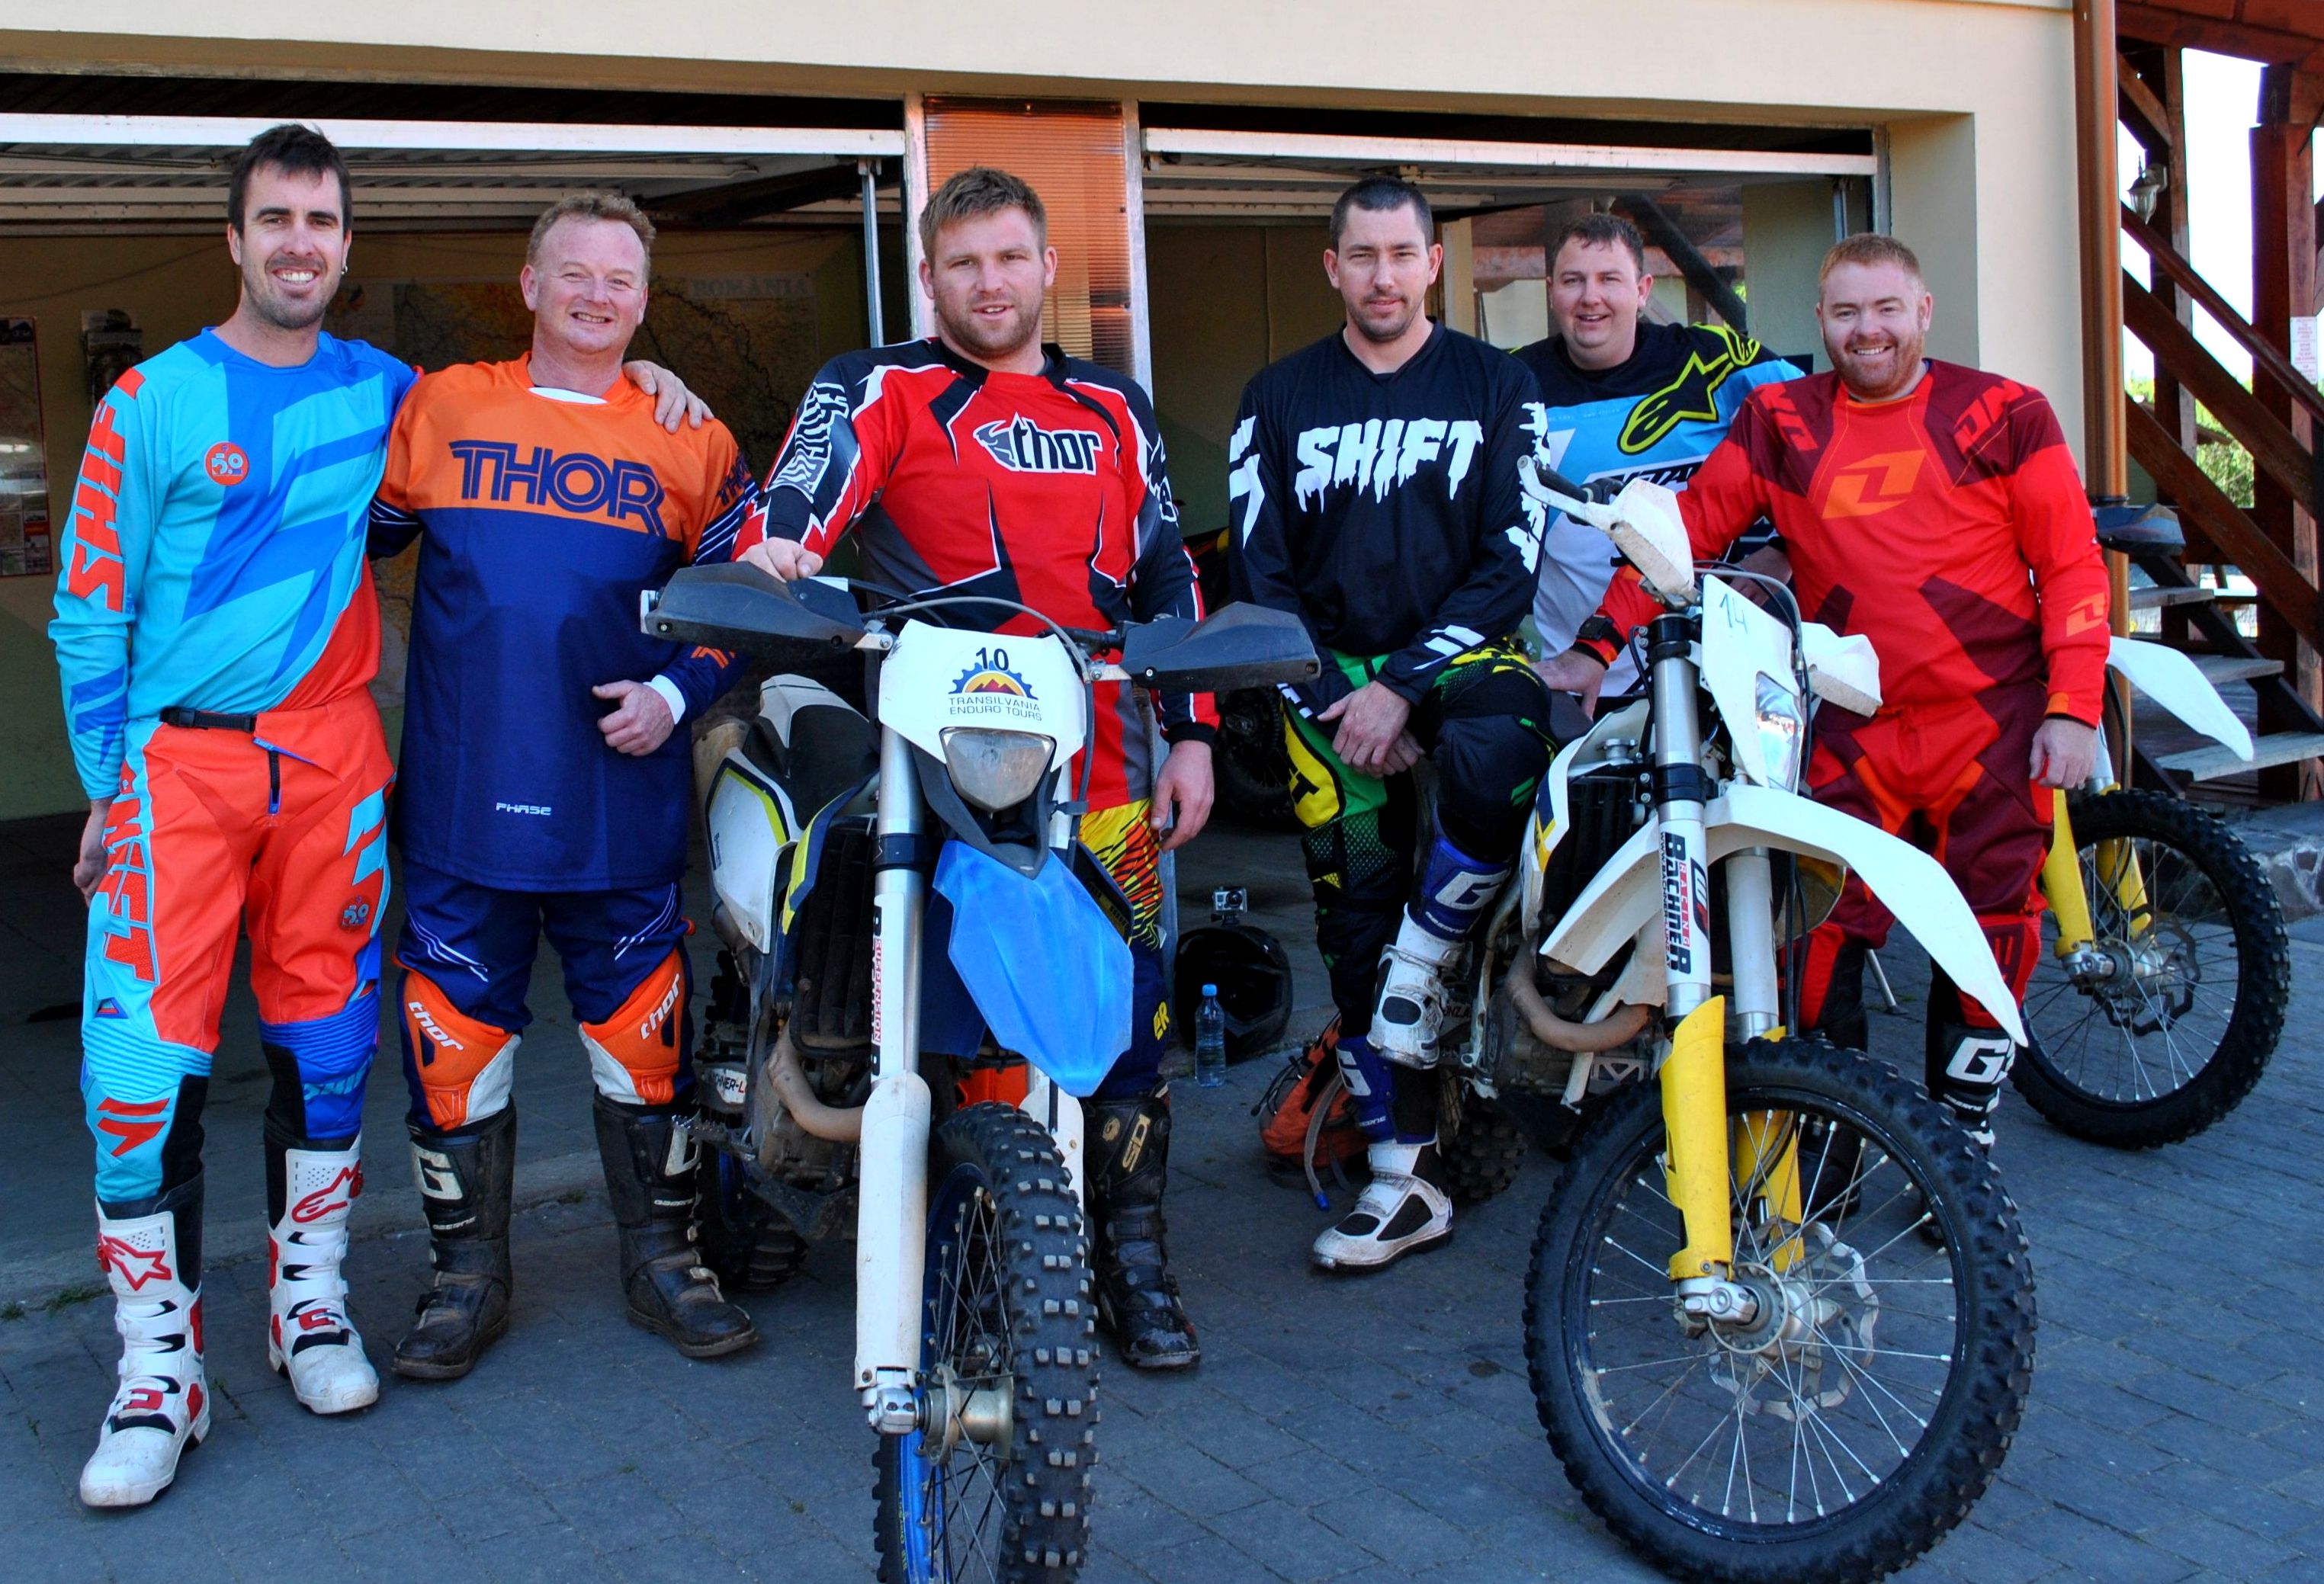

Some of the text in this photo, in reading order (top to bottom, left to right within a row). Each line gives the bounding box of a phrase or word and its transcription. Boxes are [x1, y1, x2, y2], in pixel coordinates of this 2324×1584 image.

[1011, 412, 1103, 476] thor
[1295, 418, 1485, 514] SHIFT
[449, 439, 667, 537] THOR
[1719, 592, 1748, 635] 14
[975, 646, 1010, 672] 10
[948, 696, 1041, 712] TRANSILVANIA
[949, 705, 1043, 721] ENDURO TOURS
[496, 802, 552, 816] PHASE
[1680, 862, 1690, 948] RACING
[409, 1000, 464, 1052] thor
[639, 973, 680, 1040] thor
